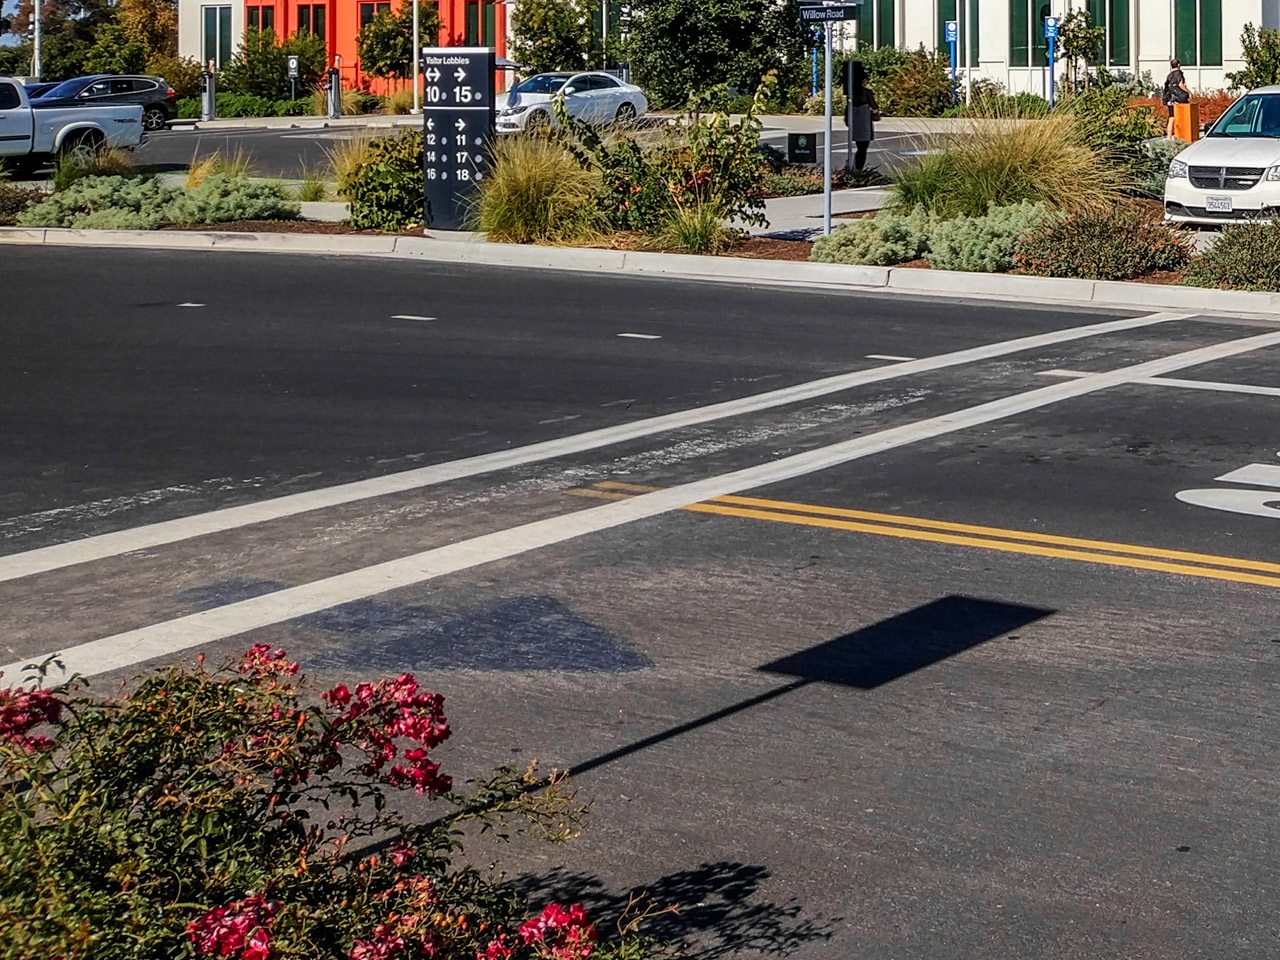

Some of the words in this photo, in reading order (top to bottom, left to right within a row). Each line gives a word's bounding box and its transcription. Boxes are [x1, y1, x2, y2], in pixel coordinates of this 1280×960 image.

[803, 10, 825, 19] Willow
[827, 9, 844, 18] Road
[443, 56, 470, 64] Lobbies
[426, 86, 439, 102] 10
[453, 86, 472, 102] 15
[426, 134, 436, 145] 12
[456, 134, 466, 145] 11
[426, 151, 436, 162] 14
[456, 152, 468, 163] 17
[426, 168, 436, 179] 16
[456, 169, 469, 180] 18
